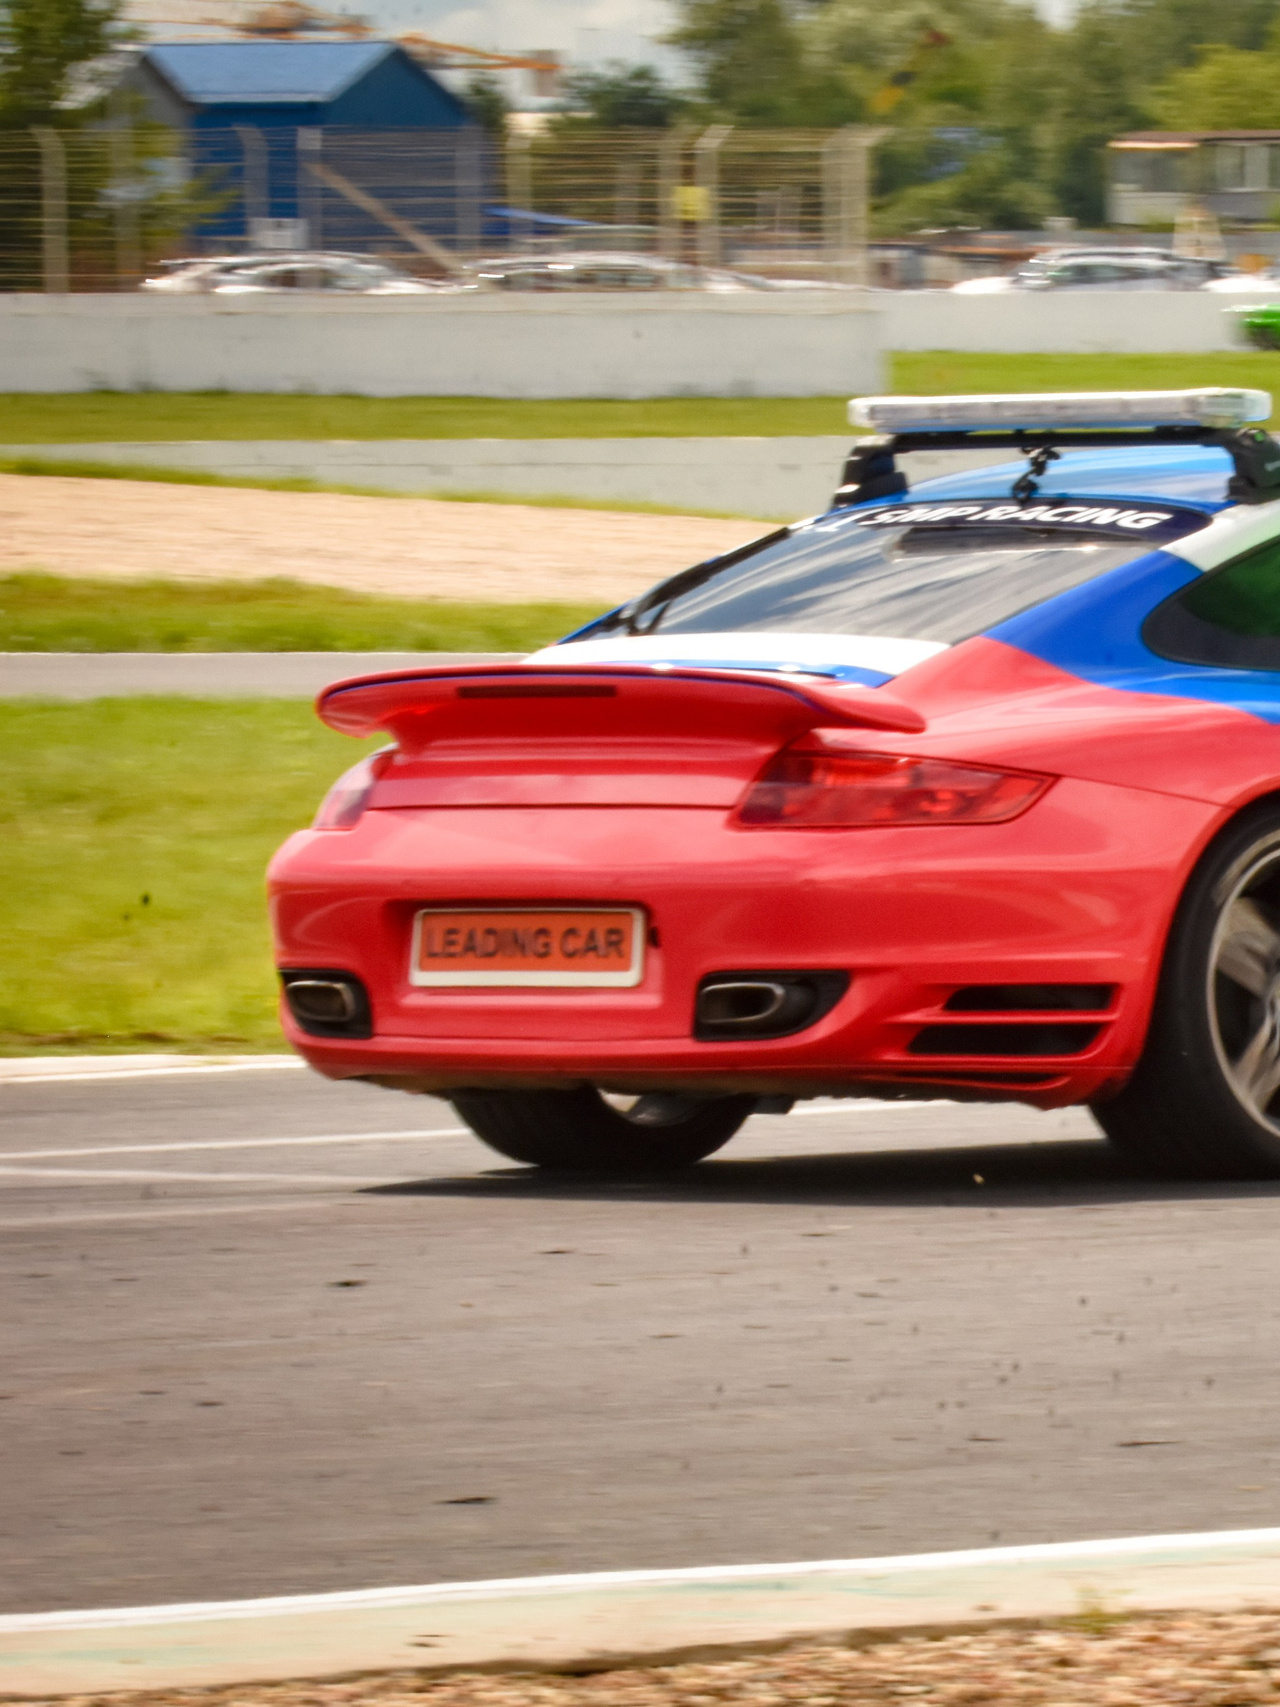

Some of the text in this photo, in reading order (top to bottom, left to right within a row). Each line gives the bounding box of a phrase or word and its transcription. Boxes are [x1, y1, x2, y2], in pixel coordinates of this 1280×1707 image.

[857, 505, 1174, 529] SMP RACING
[426, 927, 625, 959] LEADING CAR
